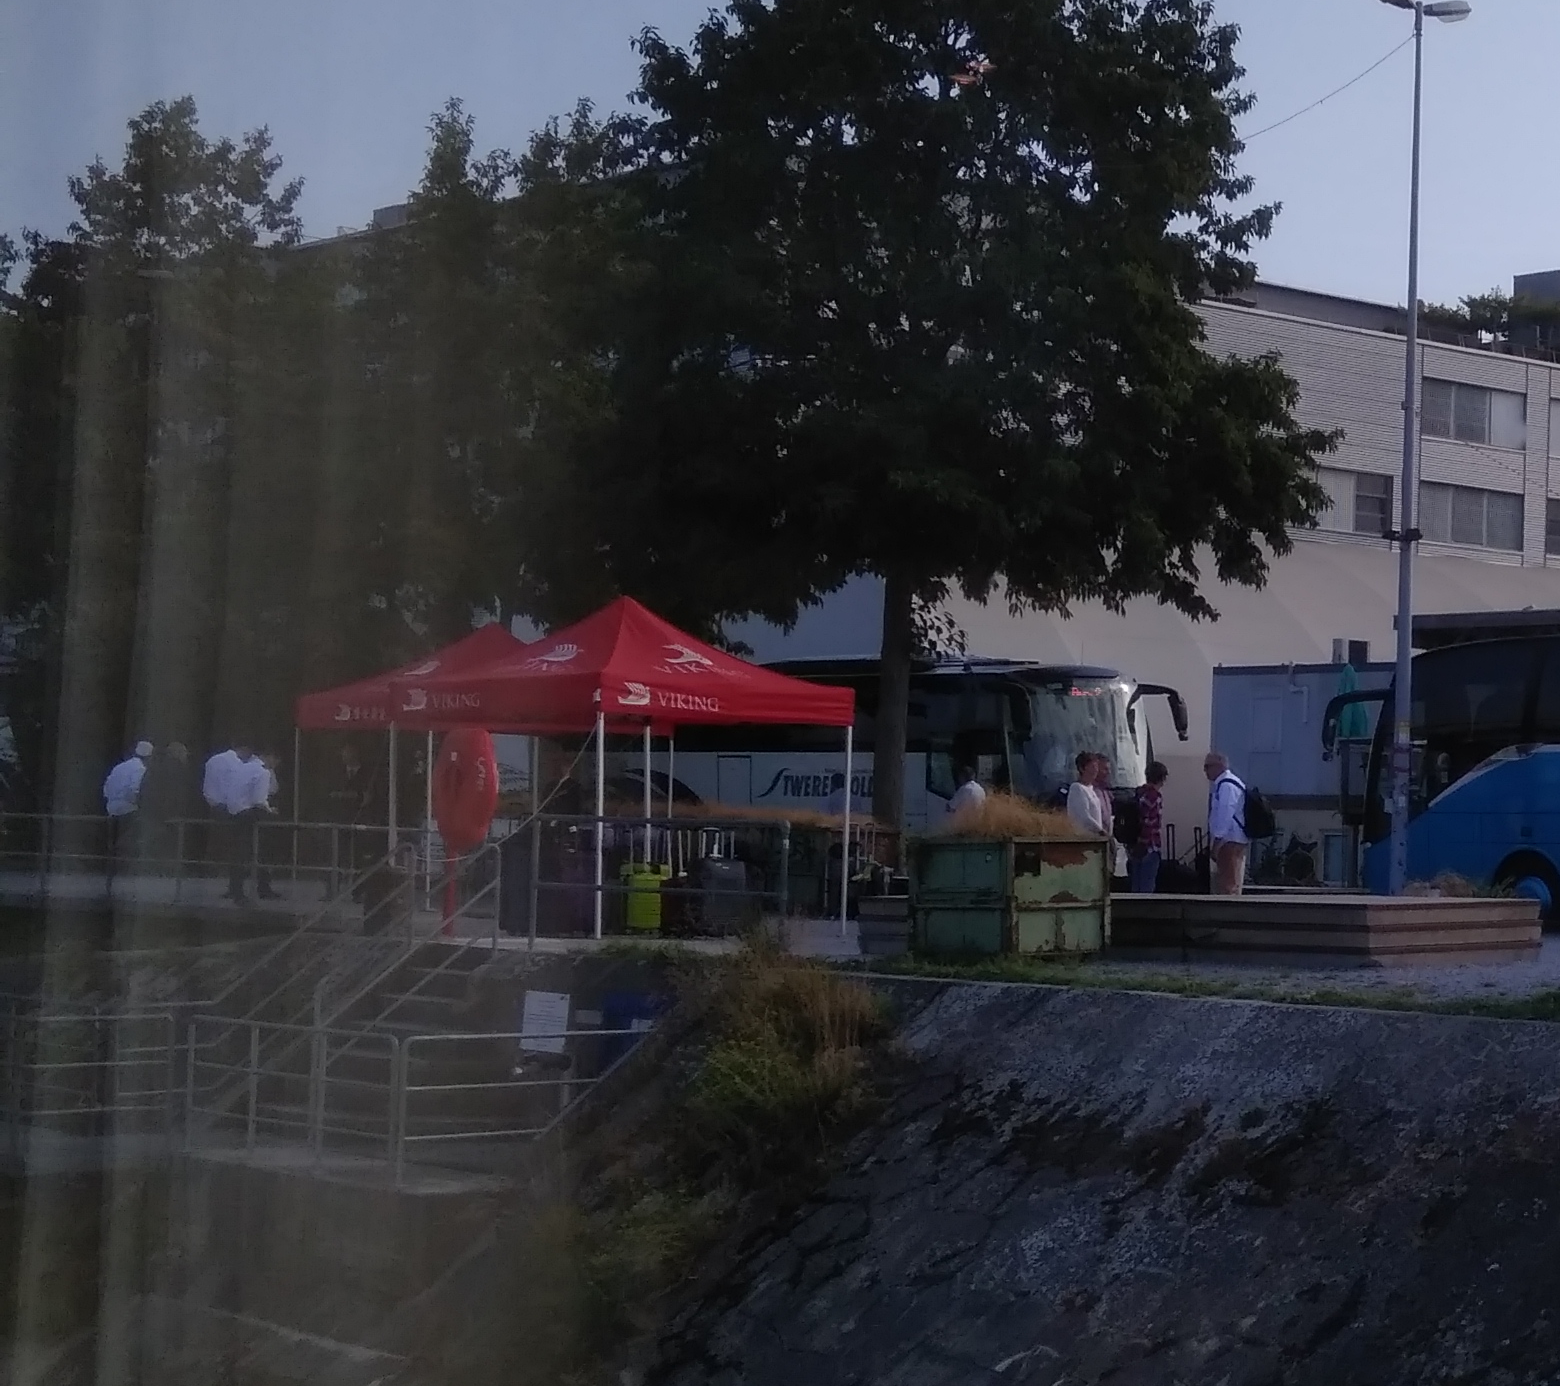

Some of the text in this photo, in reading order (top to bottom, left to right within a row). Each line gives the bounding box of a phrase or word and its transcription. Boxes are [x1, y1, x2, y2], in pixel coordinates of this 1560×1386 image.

[432, 692, 481, 709] VIKING
[656, 691, 720, 712] VIKING
[757, 767, 874, 798] STWEREOLD
